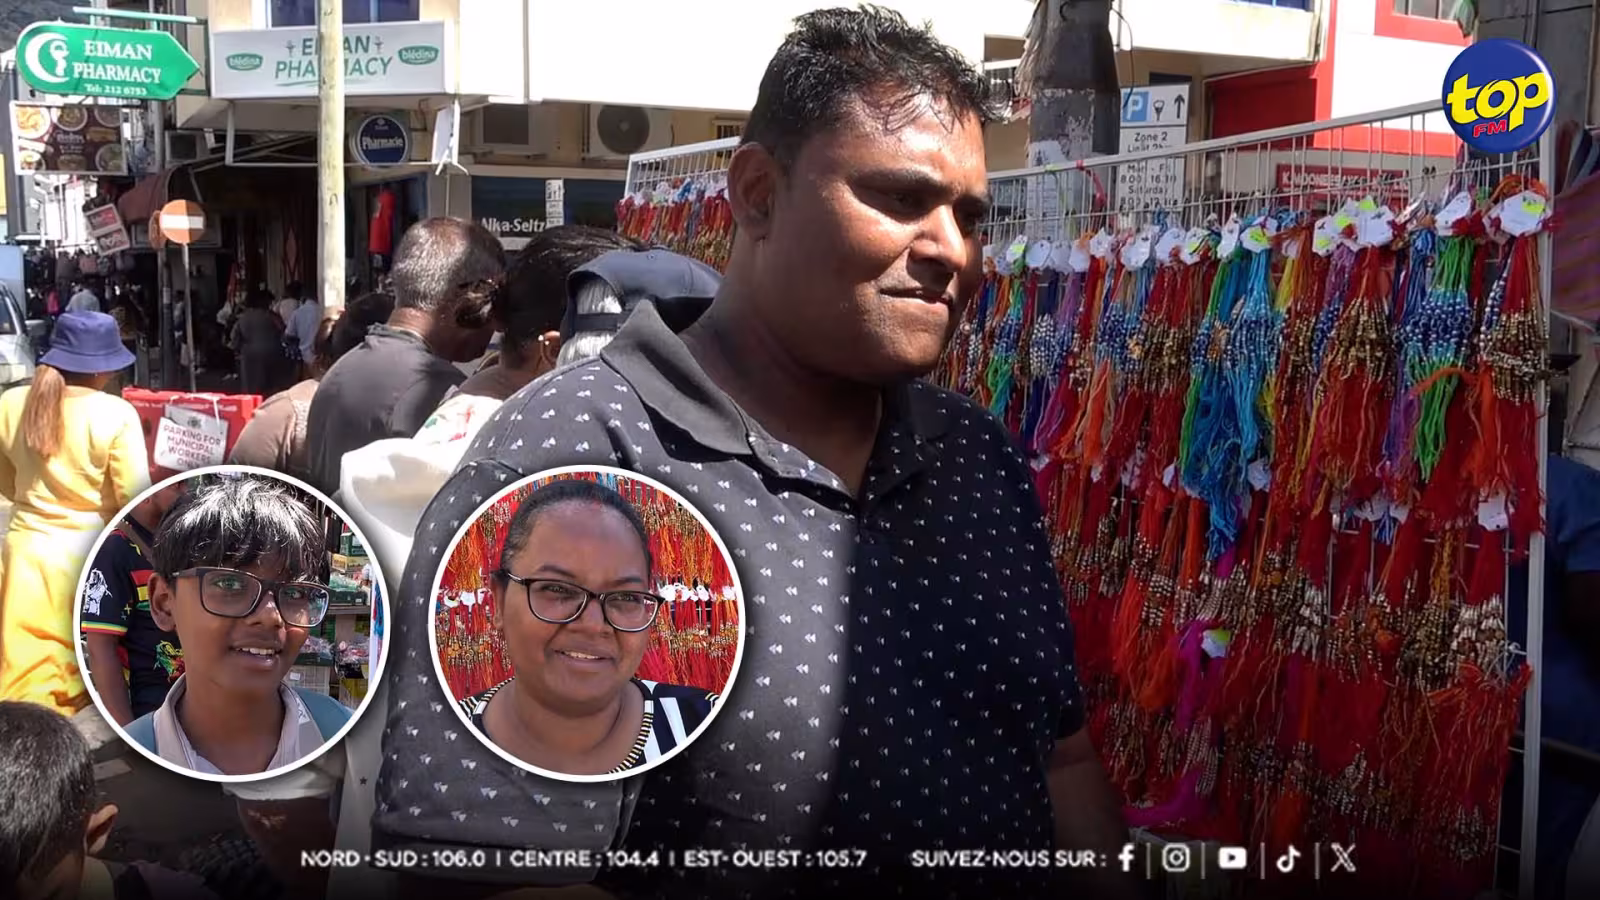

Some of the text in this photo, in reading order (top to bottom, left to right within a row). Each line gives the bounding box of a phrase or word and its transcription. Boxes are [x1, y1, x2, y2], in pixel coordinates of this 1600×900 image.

[84, 39, 152, 60] EIMAN
[302, 35, 370, 56] EIAN
[72, 62, 161, 83] PHARMACY
[275, 56, 392, 79] PHAACY
[104, 85, 121, 94] 212
[1134, 131, 1168, 142] Zone 2
[481, 217, 545, 232] Alka-Seltz
[163, 425, 221, 446] PARKING FOR
[167, 435, 215, 456] MUNICIPAL
[168, 445, 212, 464] WORKERS
